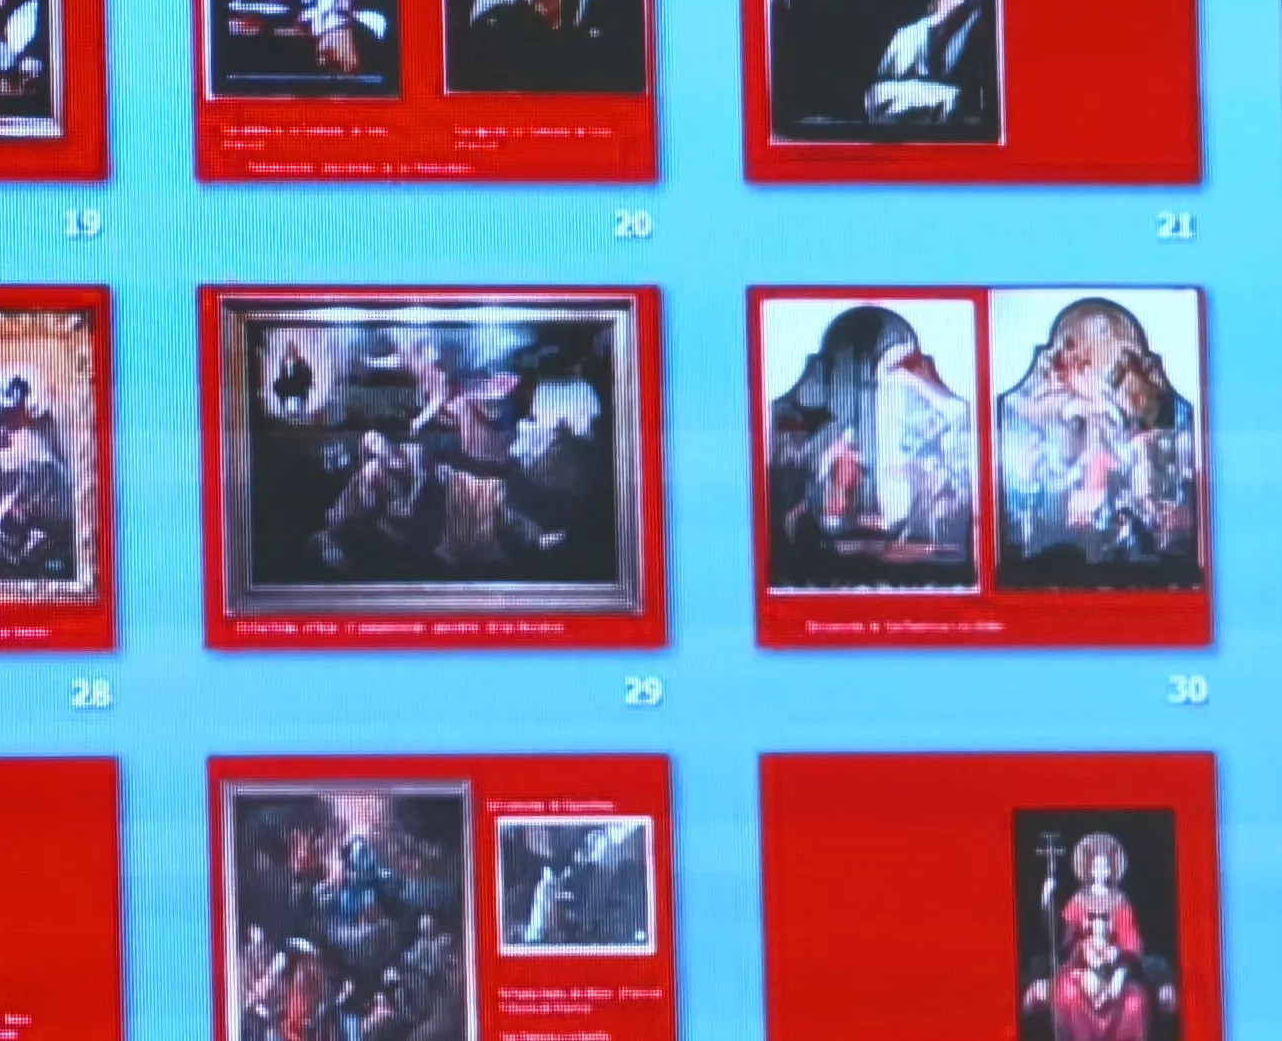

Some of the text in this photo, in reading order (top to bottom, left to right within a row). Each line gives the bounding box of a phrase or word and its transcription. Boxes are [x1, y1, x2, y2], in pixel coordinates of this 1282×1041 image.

[64, 209, 101, 237] 19
[615, 210, 652, 238] 20
[1156, 212, 1194, 239] 21
[71, 680, 111, 708] 28
[625, 676, 662, 705] 29
[1168, 675, 1207, 704] 30
